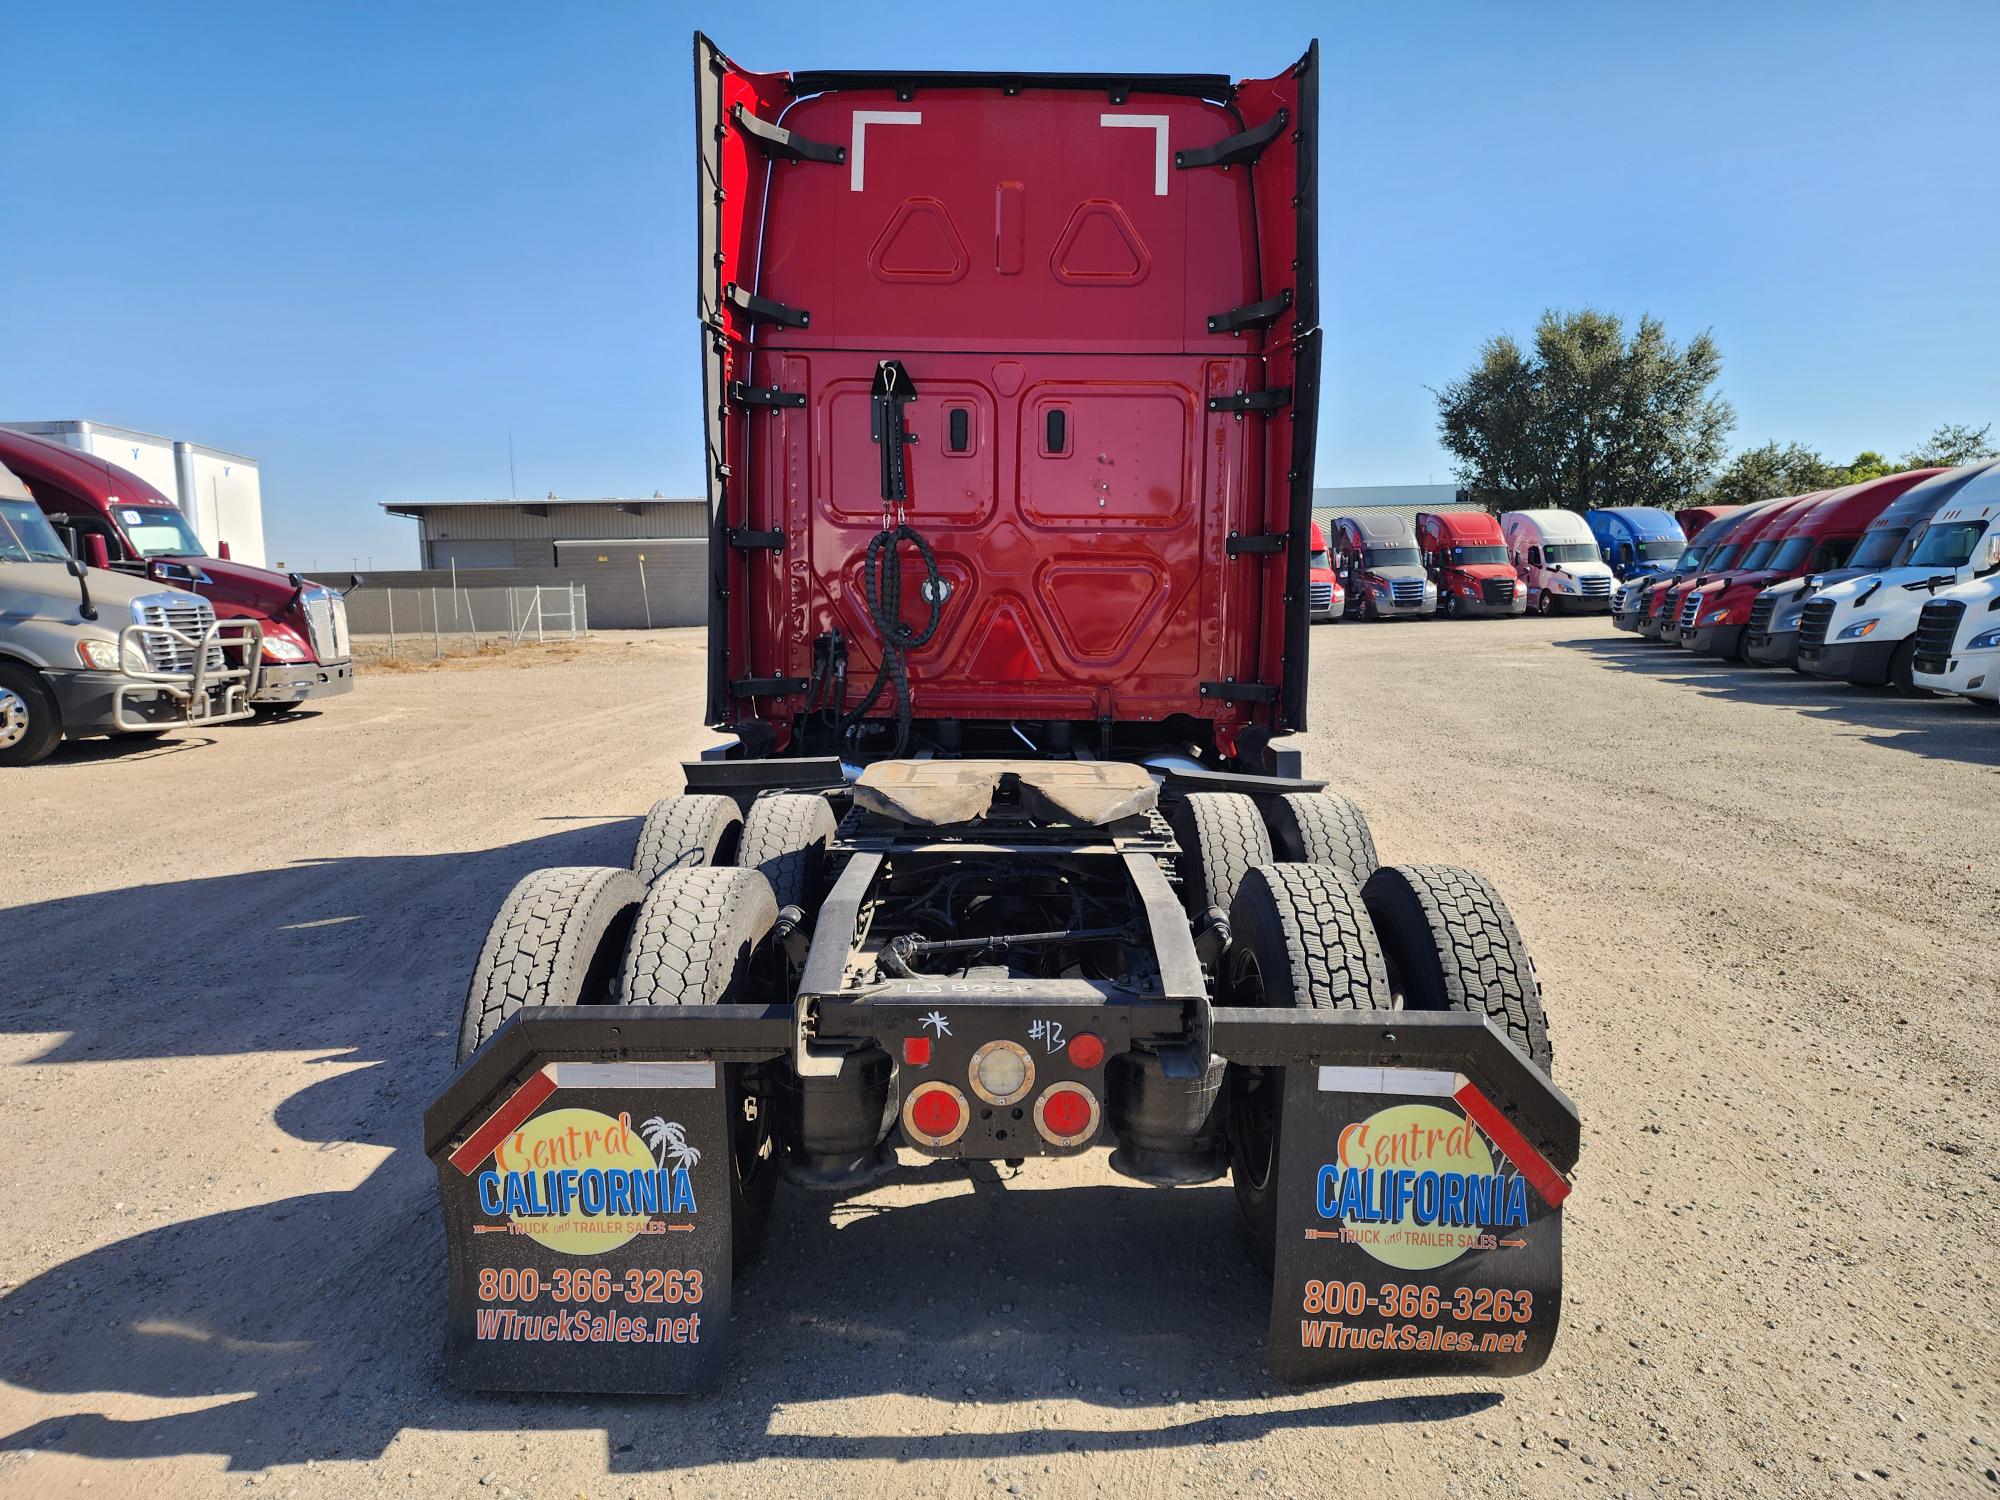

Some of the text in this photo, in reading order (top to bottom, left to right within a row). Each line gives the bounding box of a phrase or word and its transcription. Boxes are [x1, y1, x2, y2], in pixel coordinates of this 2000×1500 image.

[1027, 1019, 1066, 1055] #13
[495, 1111, 634, 1175] Central
[1337, 1114, 1476, 1172] Central
[478, 1167, 698, 1217] CALIFORNIA
[1316, 1164, 1529, 1228] CALIFORNIA
[507, 1220, 666, 1235] TRUCK and TRAILER SALES
[1339, 1228, 1497, 1250] TRUCK and TRAILER SALES
[478, 1268, 703, 1304] 800-366-3263
[1303, 1279, 1533, 1324] 800-366-3263
[476, 1309, 701, 1344] WTruckSales.net
[1300, 1320, 1527, 1353] WTruckSales.net
